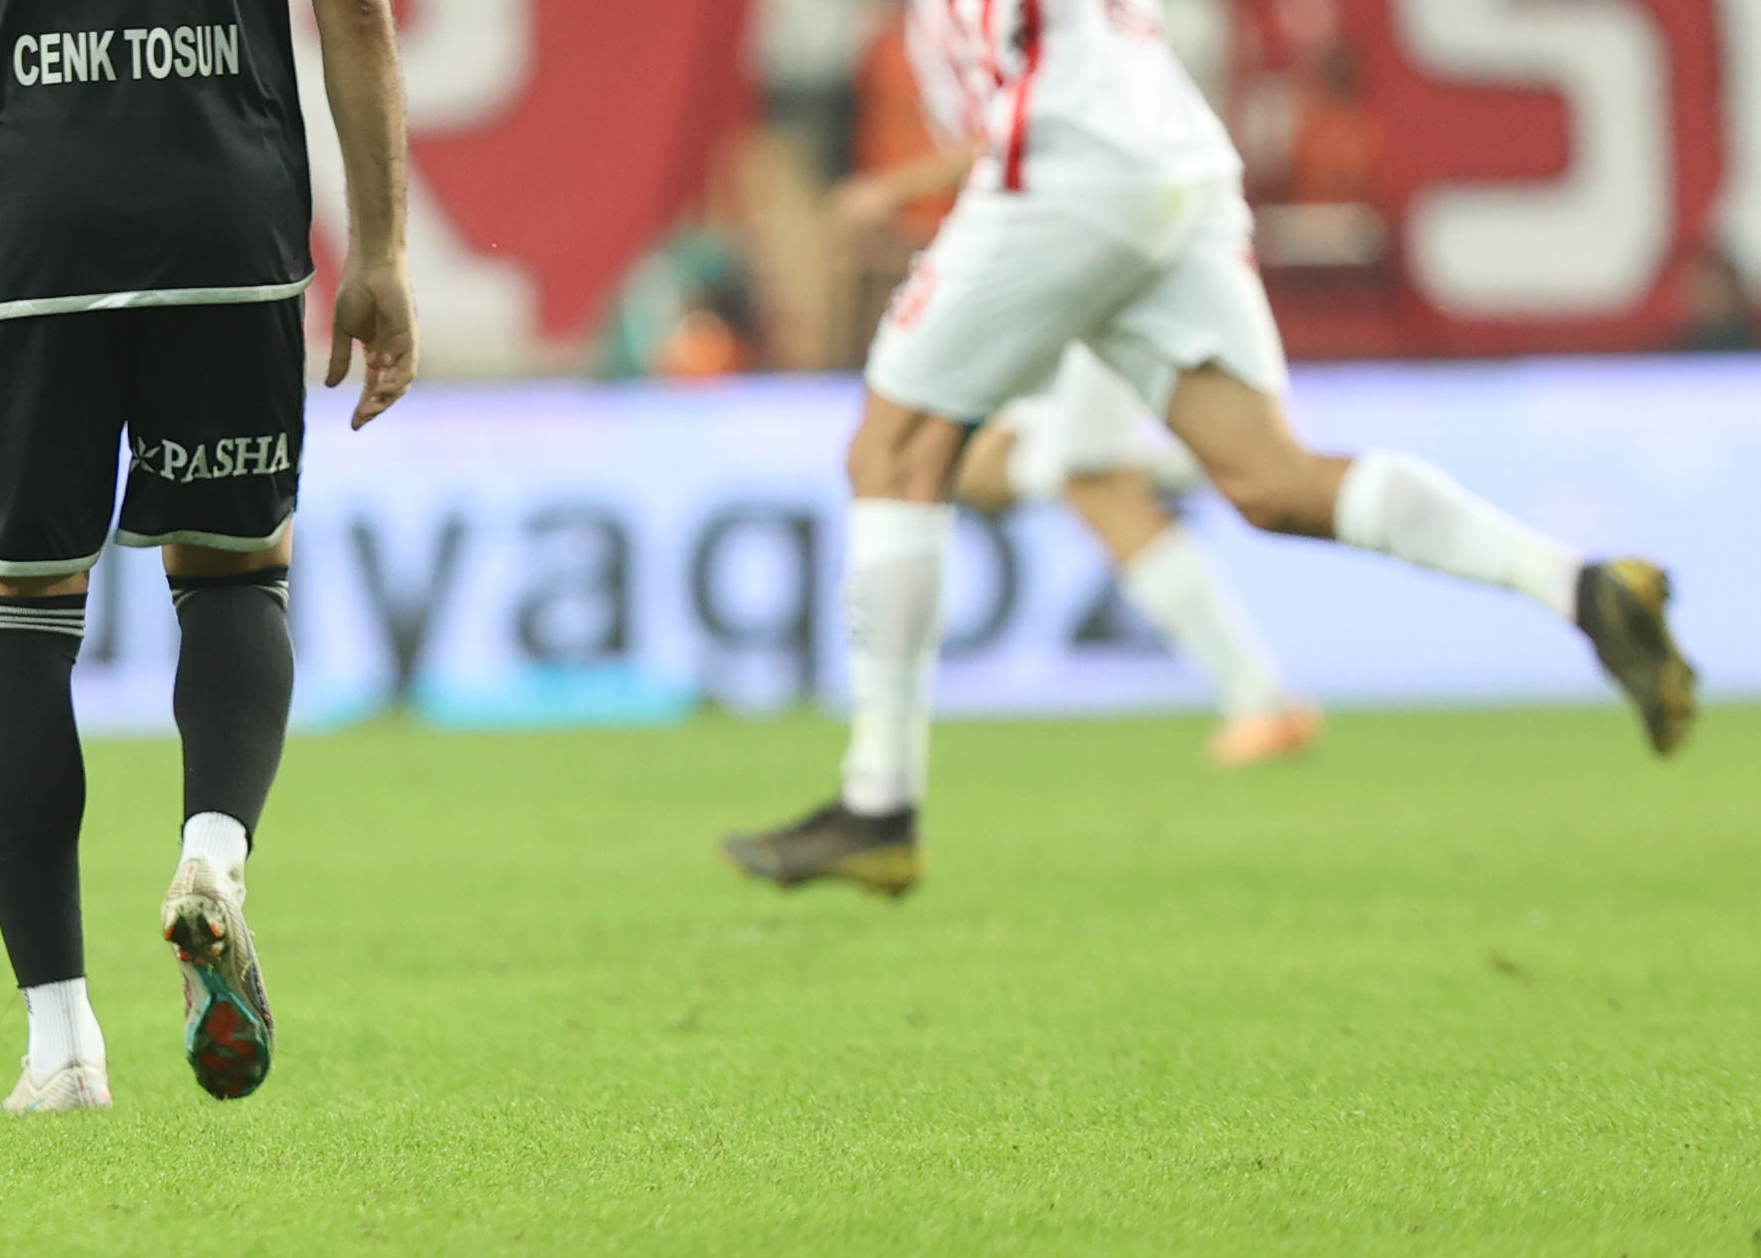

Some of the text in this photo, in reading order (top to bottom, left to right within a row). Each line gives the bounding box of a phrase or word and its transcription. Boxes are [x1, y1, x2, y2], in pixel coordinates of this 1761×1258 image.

[12, 23, 239, 87] CENK TOSUN
[159, 432, 291, 483] PASHA
